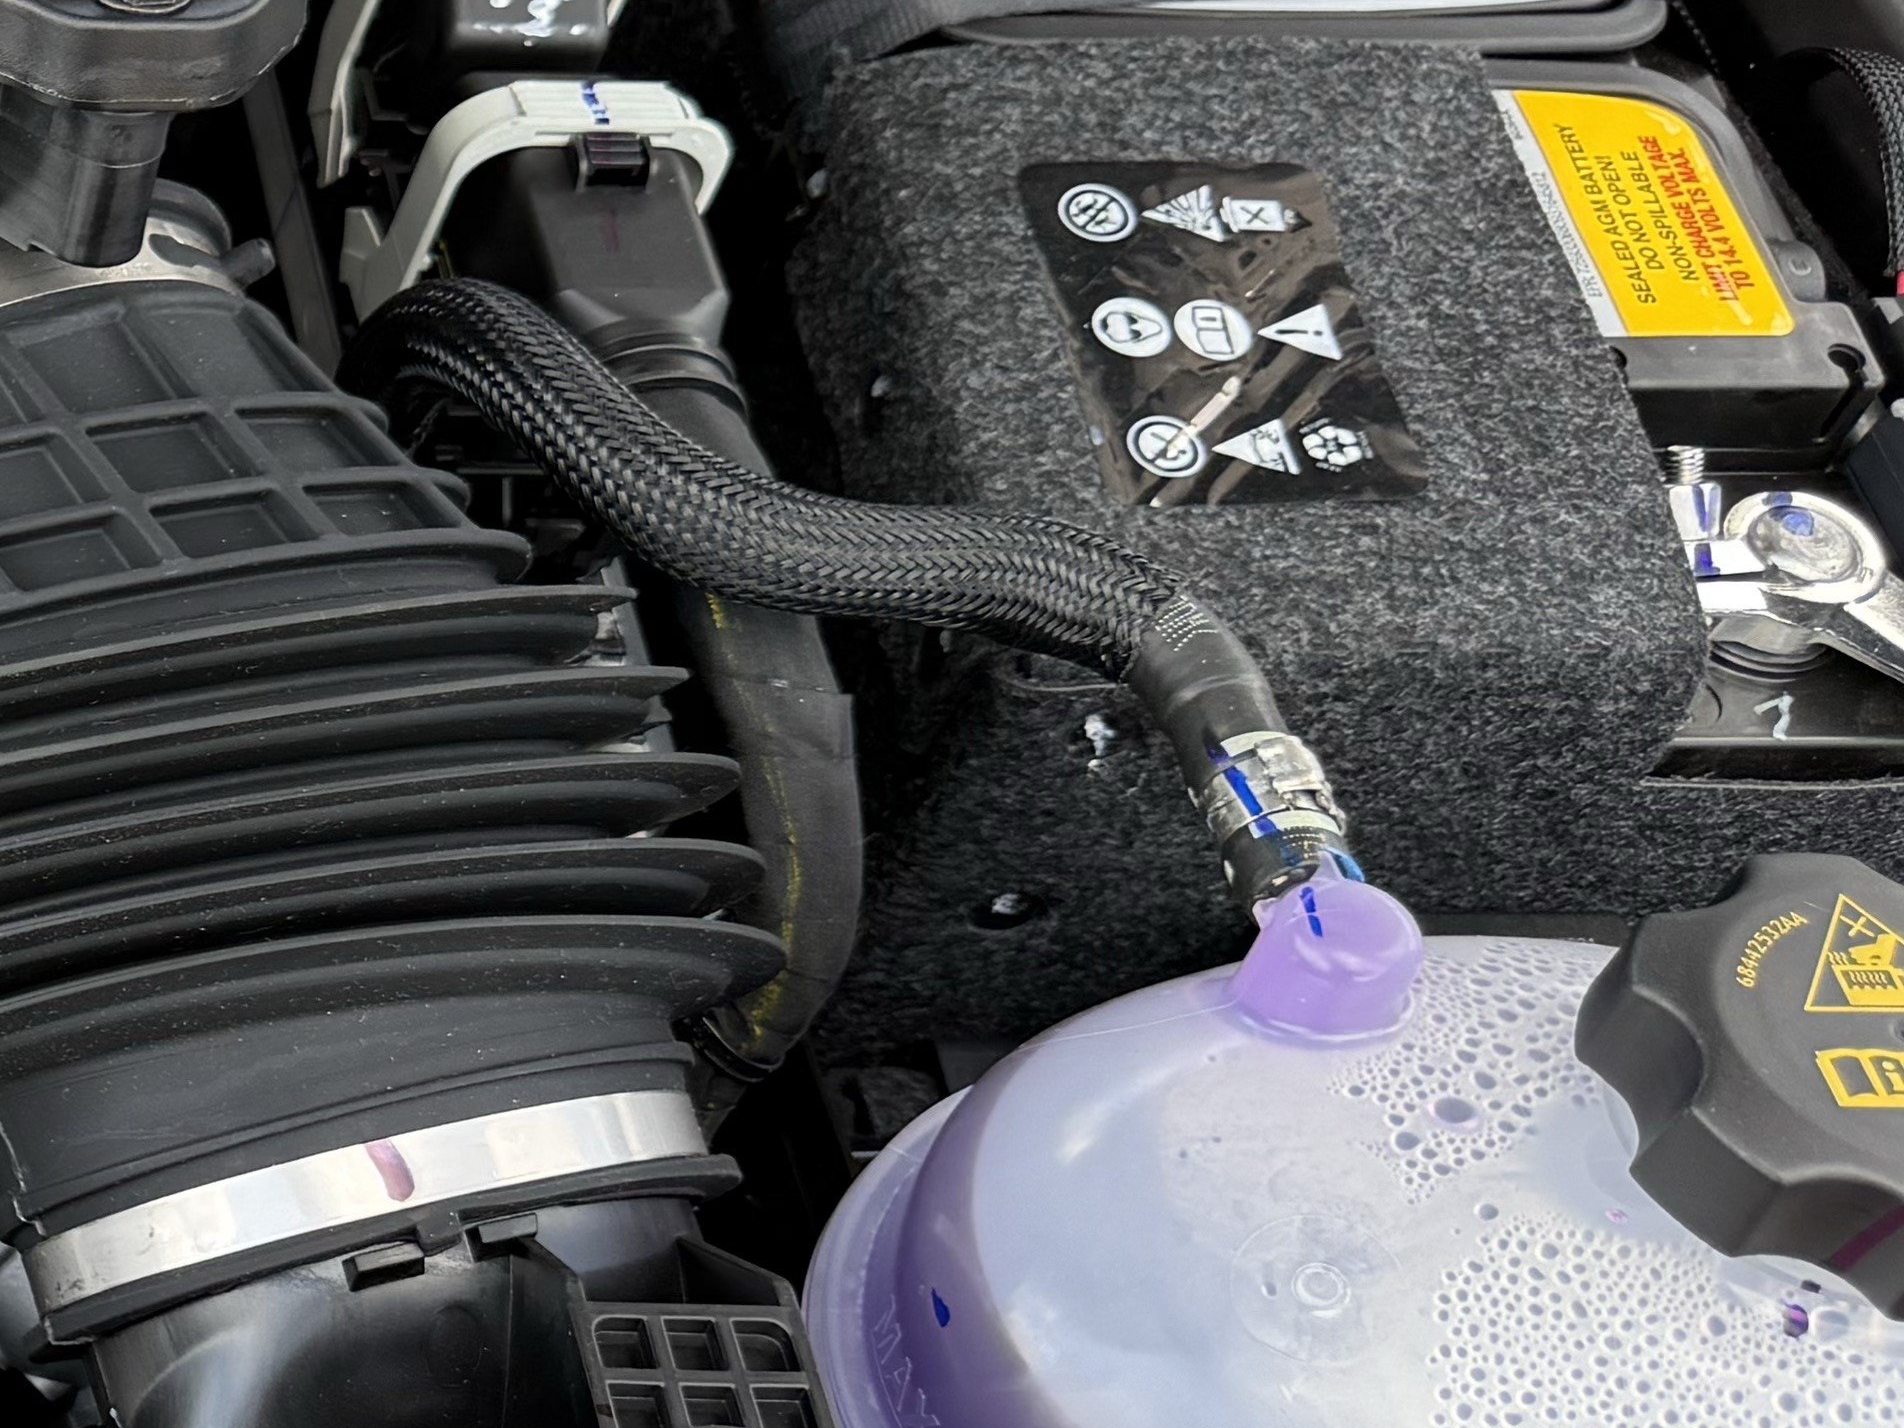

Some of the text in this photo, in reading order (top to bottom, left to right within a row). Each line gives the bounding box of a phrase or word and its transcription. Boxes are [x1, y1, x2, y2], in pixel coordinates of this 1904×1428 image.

[1554, 124, 1602, 197] BATTERY
[1590, 198, 1624, 238] AGM
[1595, 155, 1665, 271] DO NOT OPEN!
[1621, 151, 1700, 281] NON-SPILLABLE
[1638, 135, 1739, 302] LIMIT CHARGE VOLTAGE
[1668, 147, 1755, 290] TO 14.4 VOLTS MAX.
[1610, 239, 1657, 304] SEALED
[1735, 911, 1809, 989] 68442532AA
